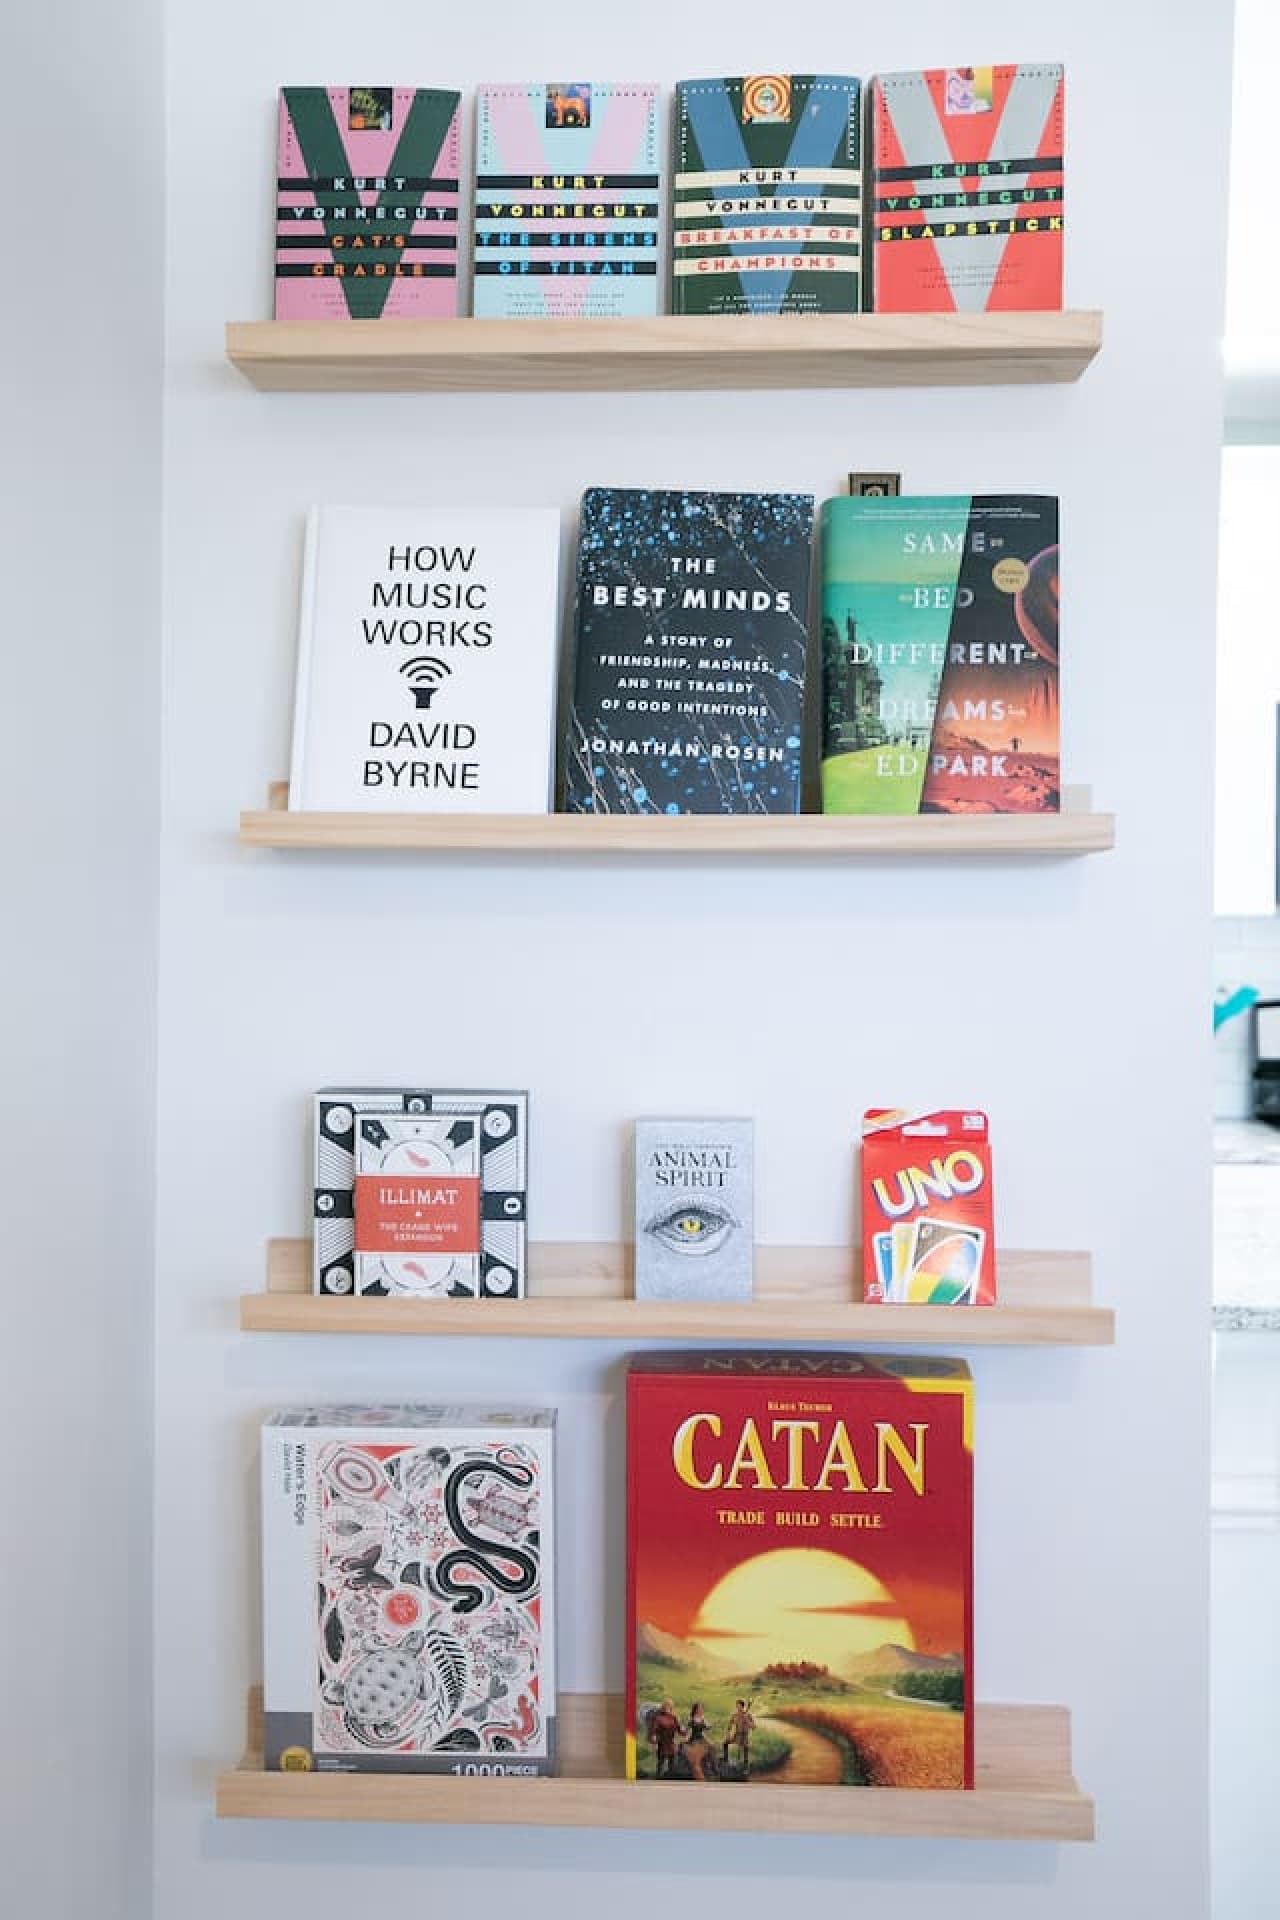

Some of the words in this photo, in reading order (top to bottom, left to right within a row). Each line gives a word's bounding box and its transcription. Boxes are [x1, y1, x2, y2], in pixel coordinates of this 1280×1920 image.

[738, 170, 799, 183] KURT
[931, 161, 1012, 178] KURT
[333, 178, 406, 191] KURT
[531, 175, 605, 188] KURT
[705, 199, 831, 213] VONNEGUT
[886, 188, 1057, 211] VONNEGUT
[293, 207, 448, 220] VONNEGUT
[491, 204, 647, 217] VONNEGUT
[680, 228, 814, 245] BREAKFAST
[828, 228, 855, 240] OF
[881, 217, 1063, 241] SLAPSTICK
[331, 235, 405, 248] CAT'S
[480, 232, 529, 246] THE
[550, 232, 655, 246] SIRENS
[312, 263, 424, 277] CRADLE
[498, 261, 529, 274] OF
[550, 261, 635, 274] TITAN
[697, 256, 836, 271] CHAMPIONS
[903, 531, 985, 553] SAME
[389, 546, 476, 572] HOW
[671, 557, 717, 574] THE
[372, 582, 487, 610] MUSIC
[593, 585, 667, 606] BEST
[682, 588, 792, 612] MINDS
[913, 587, 975, 608] BED
[361, 619, 493, 647] WORKS
[644, 634, 654, 645] A
[661, 635, 707, 647] STORY
[713, 637, 734, 648] OF
[850, 642, 1026, 664] DIFFERENT
[599, 655, 691, 669] FRIENDSHIP,
[698, 658, 775, 673] MADNESS,
[617, 678, 649, 689] AND
[656, 679, 681, 691] THE
[687, 680, 754, 693] TRAGEDY
[601, 699, 620, 710] OF
[626, 700, 671, 712] GOOD
[677, 702, 768, 717] INTENTIONS
[879, 699, 1007, 720] DREAMS
[369, 722, 477, 749] DAVID
[579, 738, 700, 757] JONATHAN
[711, 745, 785, 761] ROSEN
[362, 760, 480, 788] BYRNE
[876, 754, 918, 777] ED
[932, 754, 1010, 777] PARK
[648, 1151, 737, 1169] ANIMAL
[655, 1169, 729, 1187] SPIRIT
[870, 1149, 986, 1219] UNO
[379, 1188, 459, 1205] ILLIMAT
[672, 1412, 930, 1497] CATAN
[716, 1509, 766, 1526] TRADE
[775, 1510, 820, 1527] BUILD
[830, 1512, 882, 1529] SETTLE
